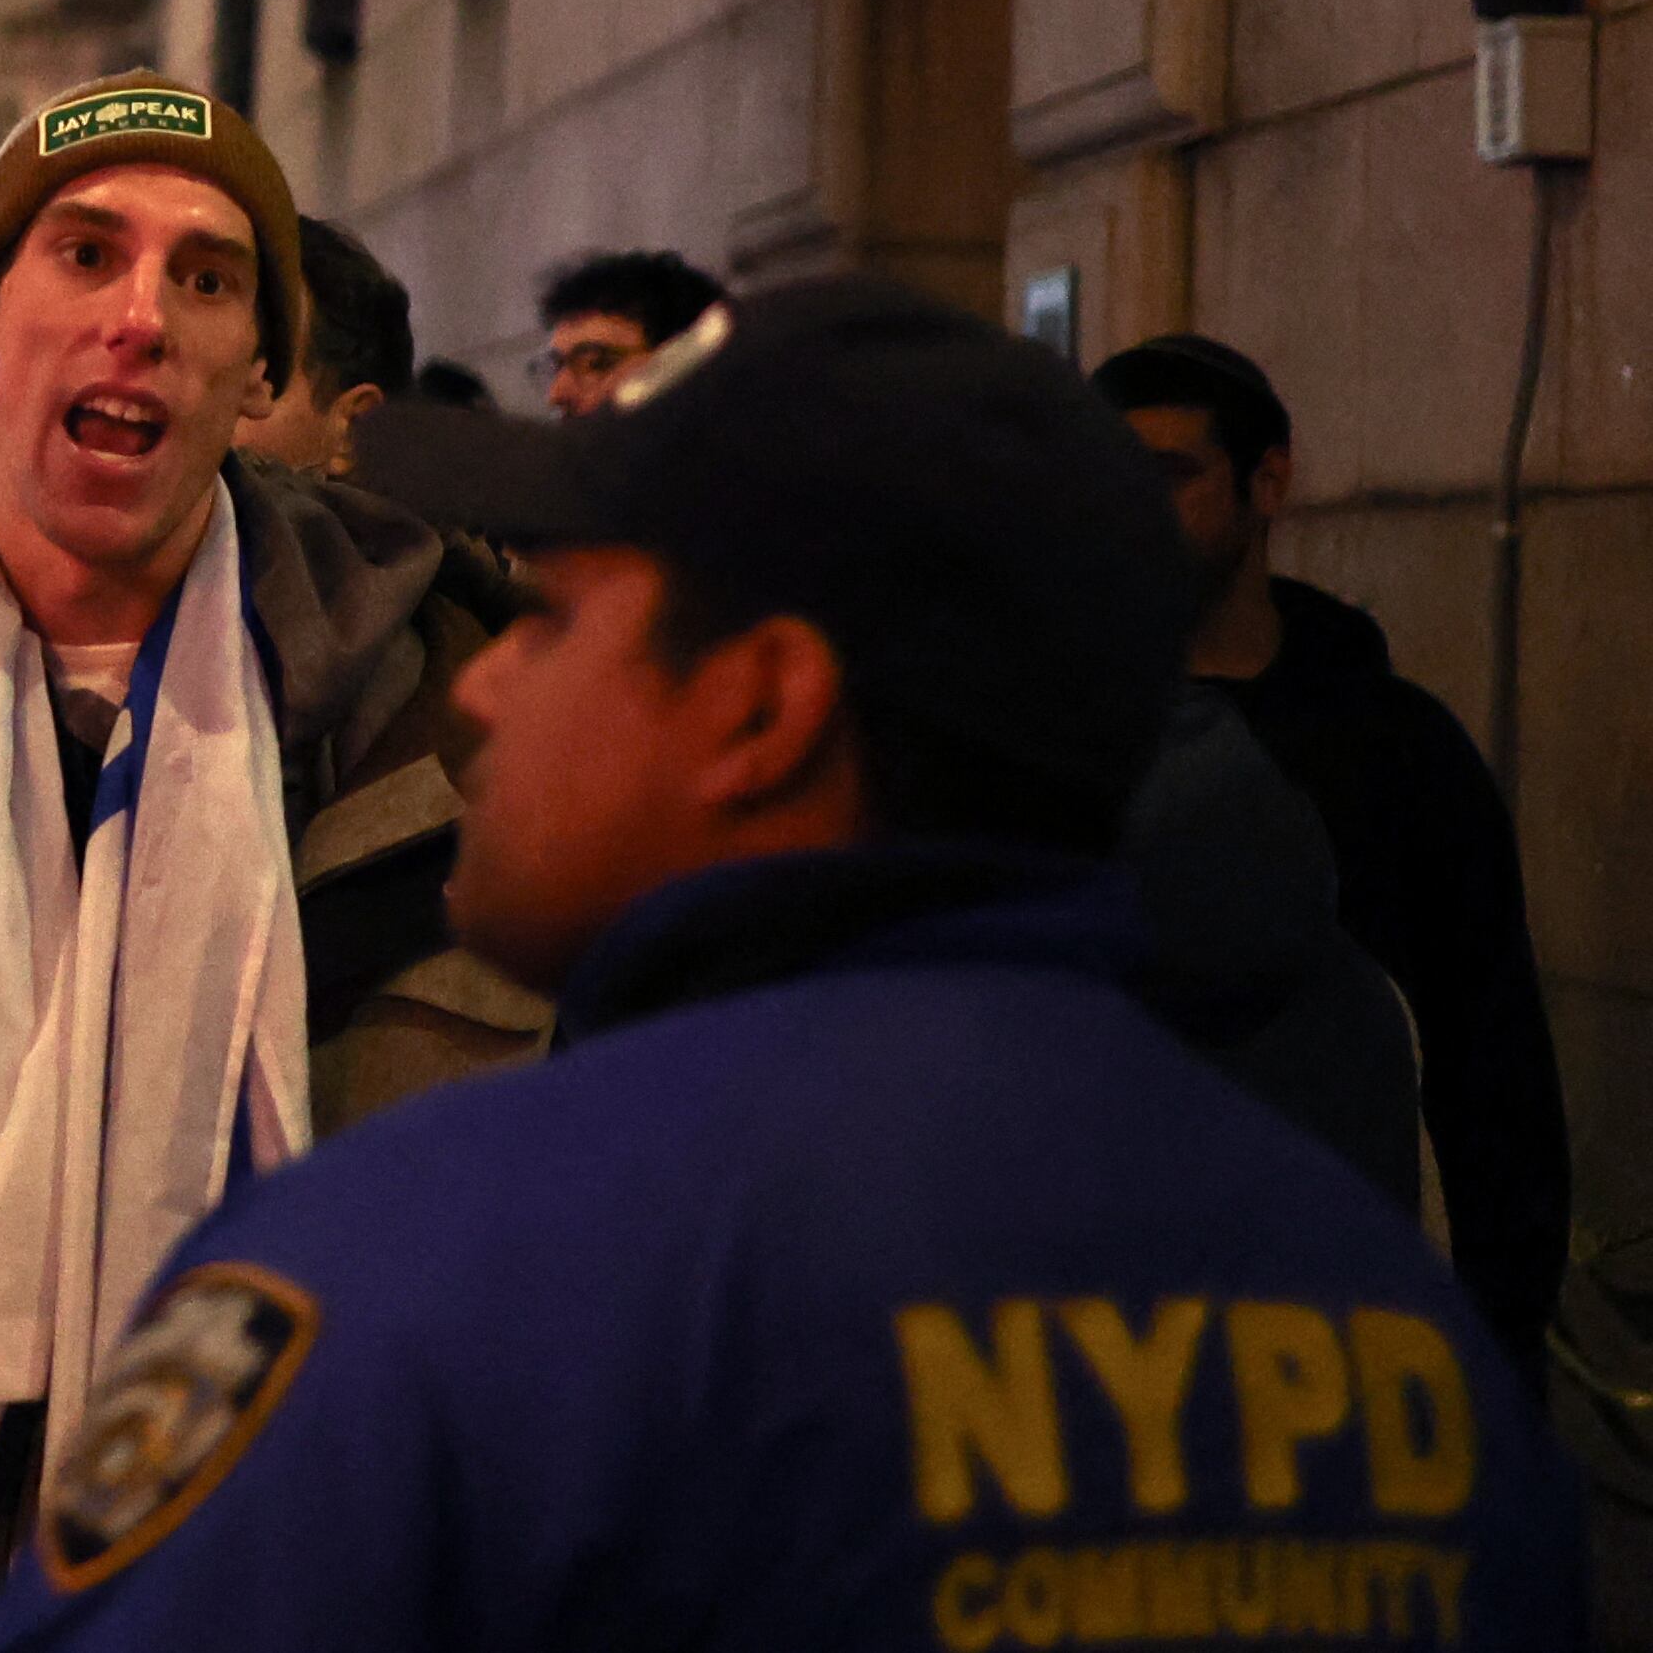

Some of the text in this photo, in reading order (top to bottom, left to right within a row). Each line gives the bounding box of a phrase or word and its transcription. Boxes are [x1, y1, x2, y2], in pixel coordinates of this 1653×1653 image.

[51, 101, 198, 138] JAY PEAK
[895, 1295, 1477, 1524] NYPD
[933, 1541, 1470, 1650] COMMUNITY
